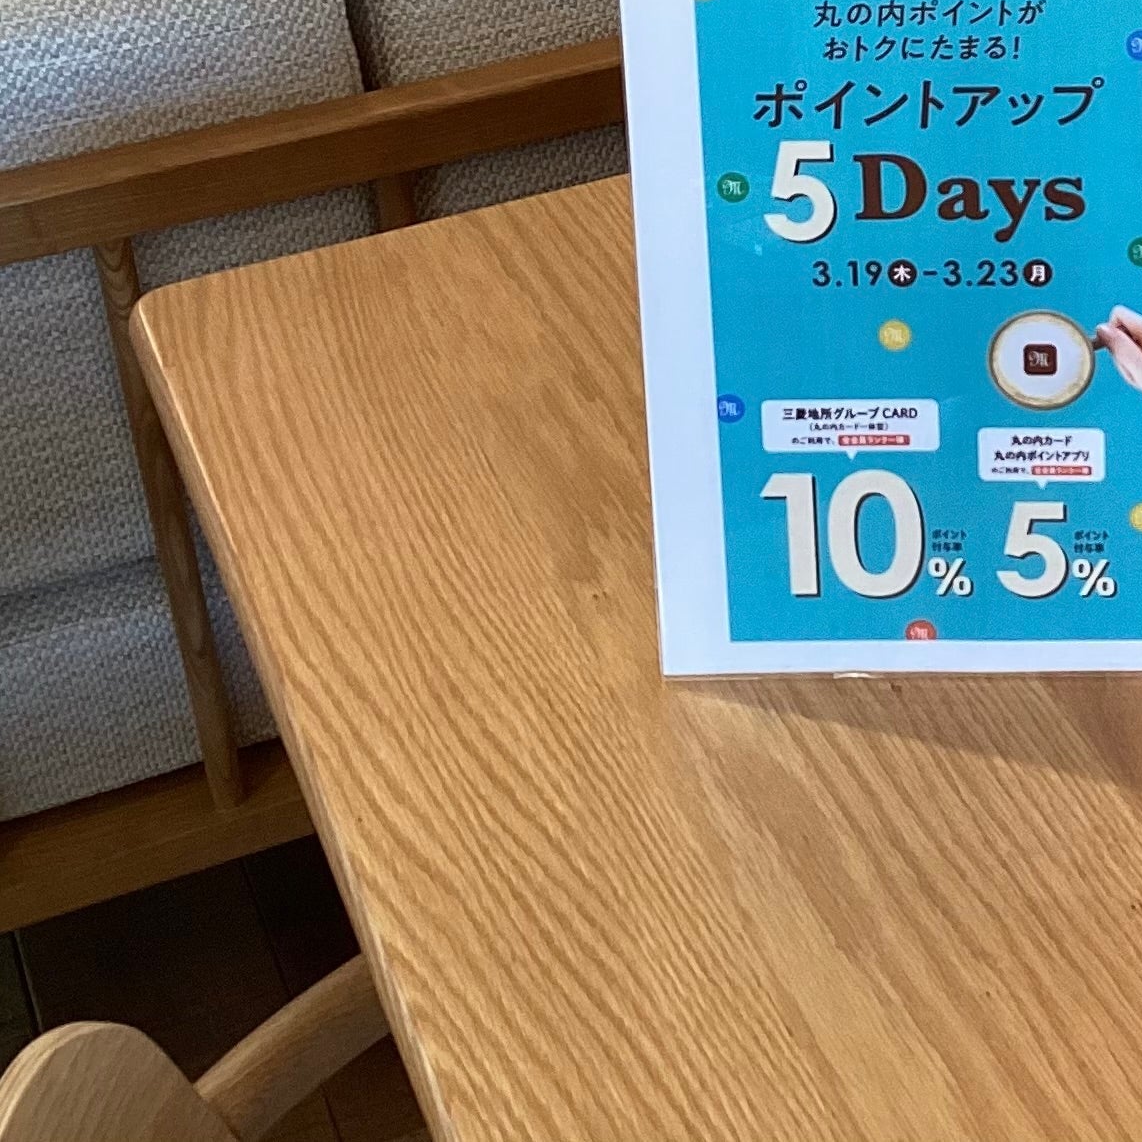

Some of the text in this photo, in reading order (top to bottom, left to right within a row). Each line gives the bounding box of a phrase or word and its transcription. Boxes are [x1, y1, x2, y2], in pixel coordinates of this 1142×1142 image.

[822, 34, 1021, 62] おトクにたまる!
[753, 76, 1105, 129] ポイントアップ
[763, 140, 1087, 243] 5 Days
[882, 407, 919, 420] CARD
